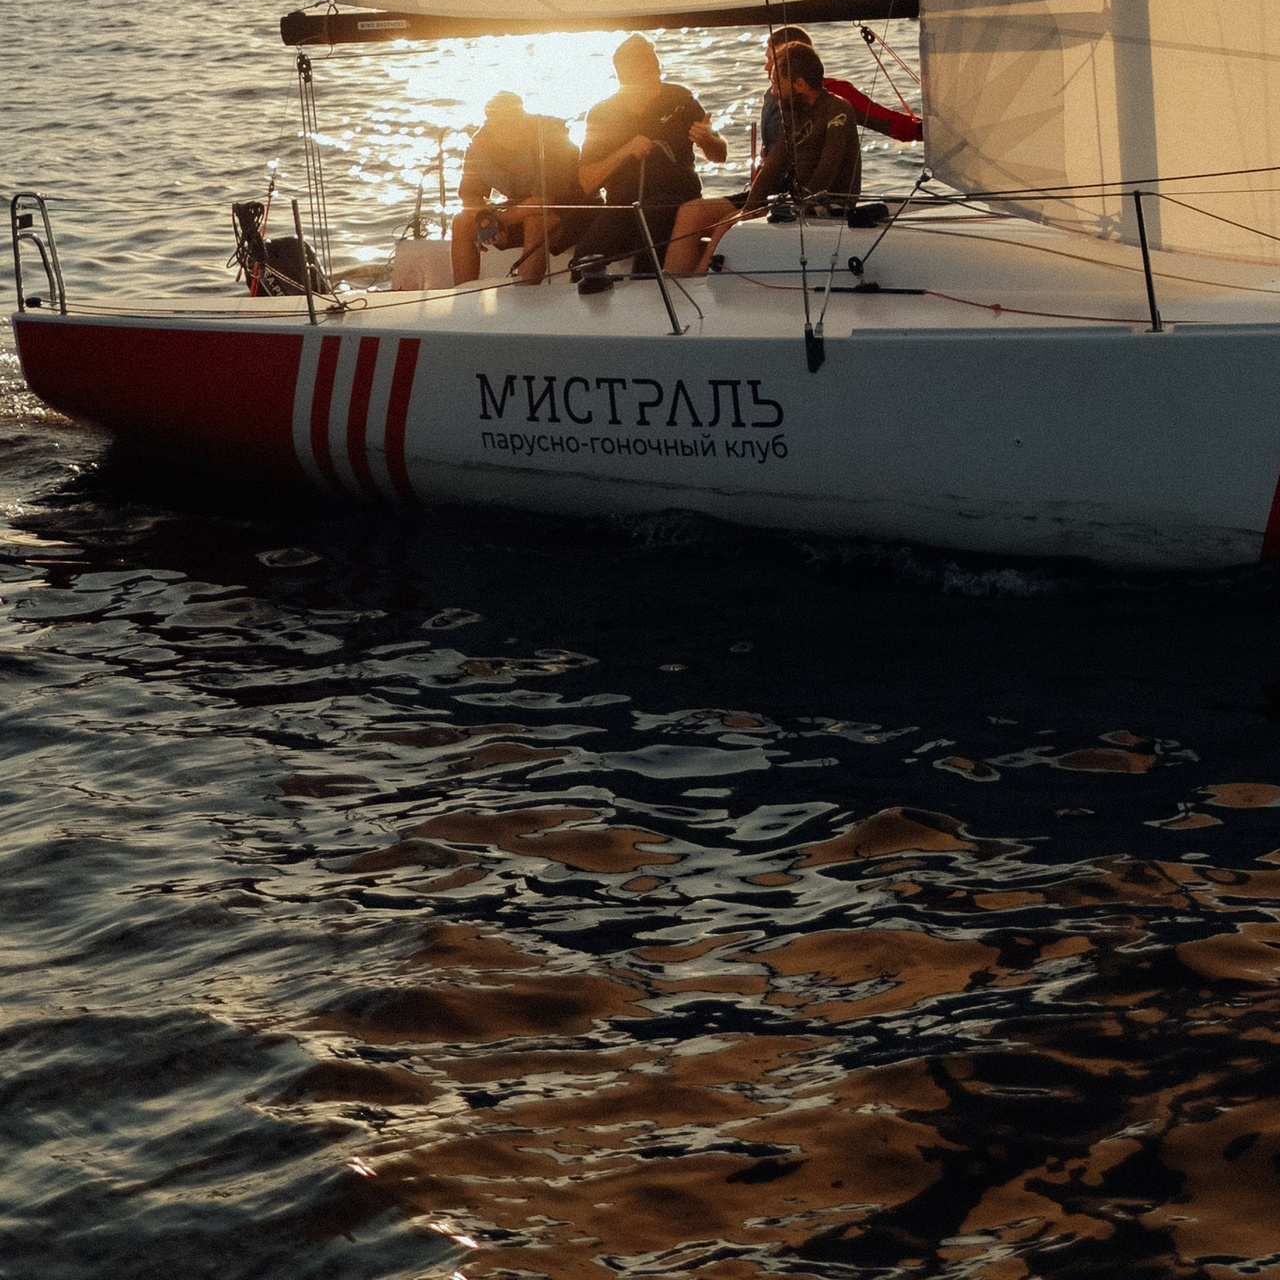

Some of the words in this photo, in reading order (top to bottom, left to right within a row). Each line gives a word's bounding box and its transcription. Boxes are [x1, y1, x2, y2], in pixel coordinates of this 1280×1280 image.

[475, 373, 785, 428] МИСТРАЛЬ
[481, 431, 717, 457] парусно-гоночный
[726, 434, 789, 464] клуб
